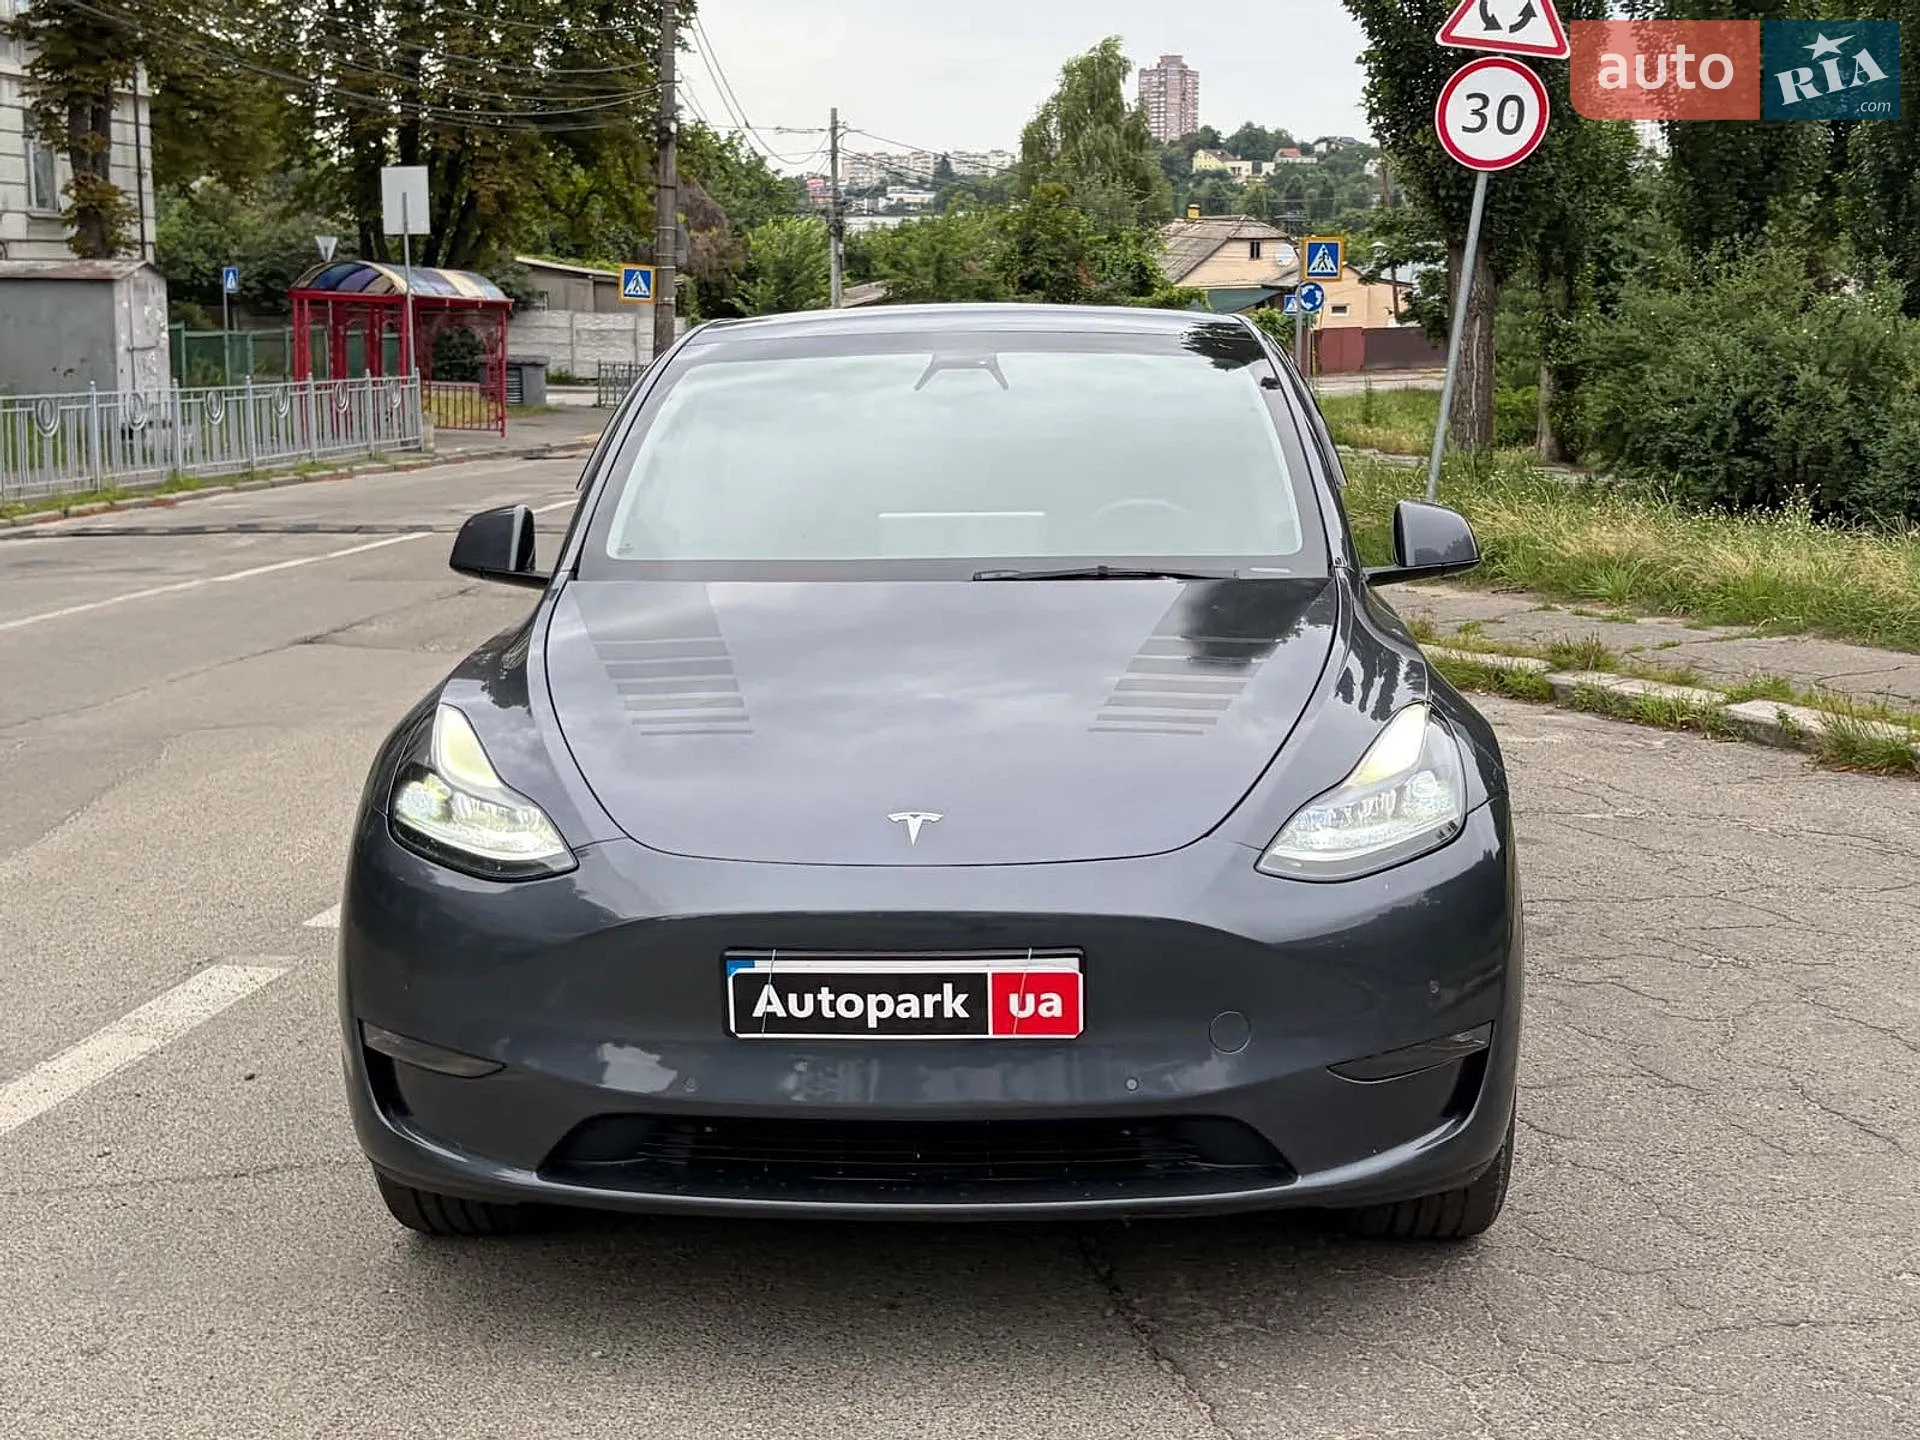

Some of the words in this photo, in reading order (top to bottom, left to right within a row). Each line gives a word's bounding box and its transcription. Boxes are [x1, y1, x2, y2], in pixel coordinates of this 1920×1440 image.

[1461, 92, 1525, 136] 30
[752, 983, 969, 1028] Autopark
[1009, 991, 1062, 1018] ua
